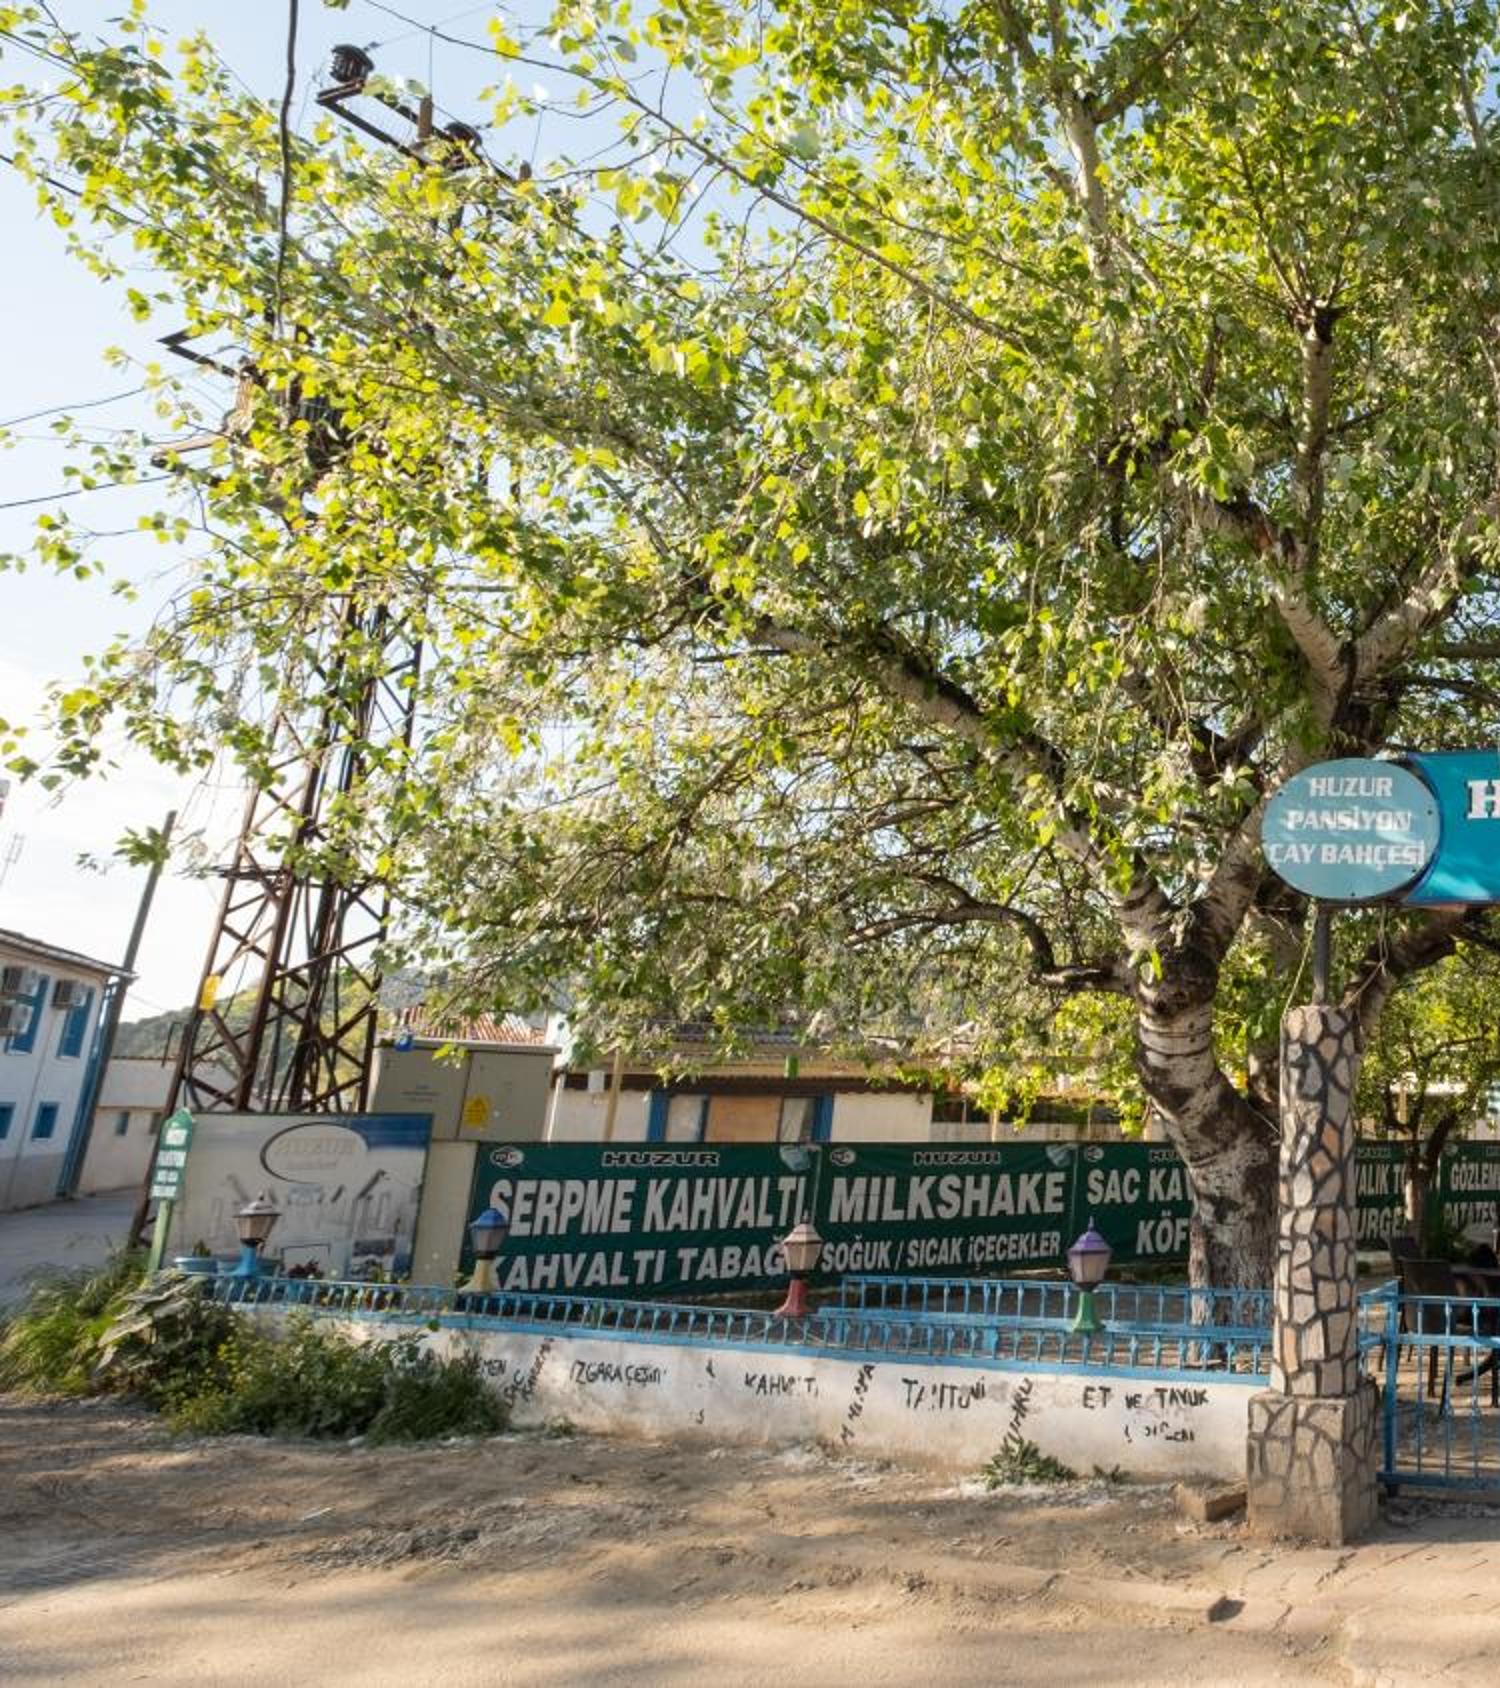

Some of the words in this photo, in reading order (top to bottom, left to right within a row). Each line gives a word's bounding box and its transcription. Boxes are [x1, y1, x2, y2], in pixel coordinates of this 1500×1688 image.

[1309, 777, 1393, 797] HUZUR
[1283, 804, 1412, 833] PANSİYON
[1320, 838, 1425, 873] BAHÇESİ
[602, 1151, 721, 1167] HUZUR
[913, 1152, 1001, 1165] HUZUR
[829, 1172, 1066, 1224] MILKSHAKE
[1086, 1168, 1141, 1205] SAC
[489, 1178, 637, 1237] SERPME
[642, 1176, 806, 1232] KAHVALTI
[820, 1236, 893, 1273] SOĞUK
[906, 1236, 966, 1268] SICAK
[1082, 1386, 1112, 1409] ET
[1154, 1387, 1209, 1409] TAVUK
